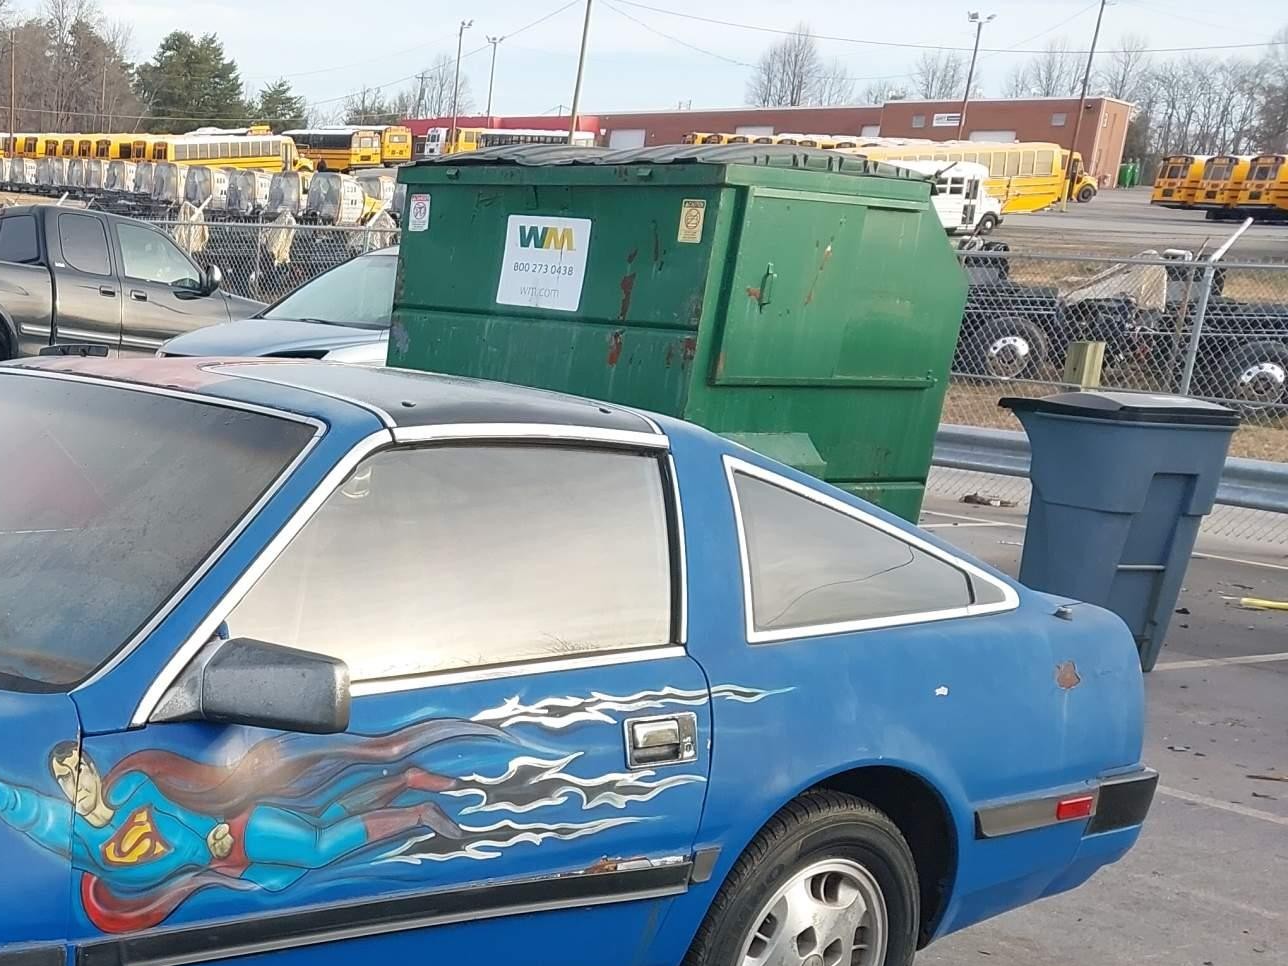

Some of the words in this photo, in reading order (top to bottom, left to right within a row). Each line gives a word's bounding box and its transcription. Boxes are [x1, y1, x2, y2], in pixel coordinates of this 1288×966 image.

[519, 225, 574, 251] WM
[513, 262, 530, 272] 800
[531, 263, 549, 274] 273
[550, 265, 574, 276] 0438
[520, 286, 560, 298] wm.com
